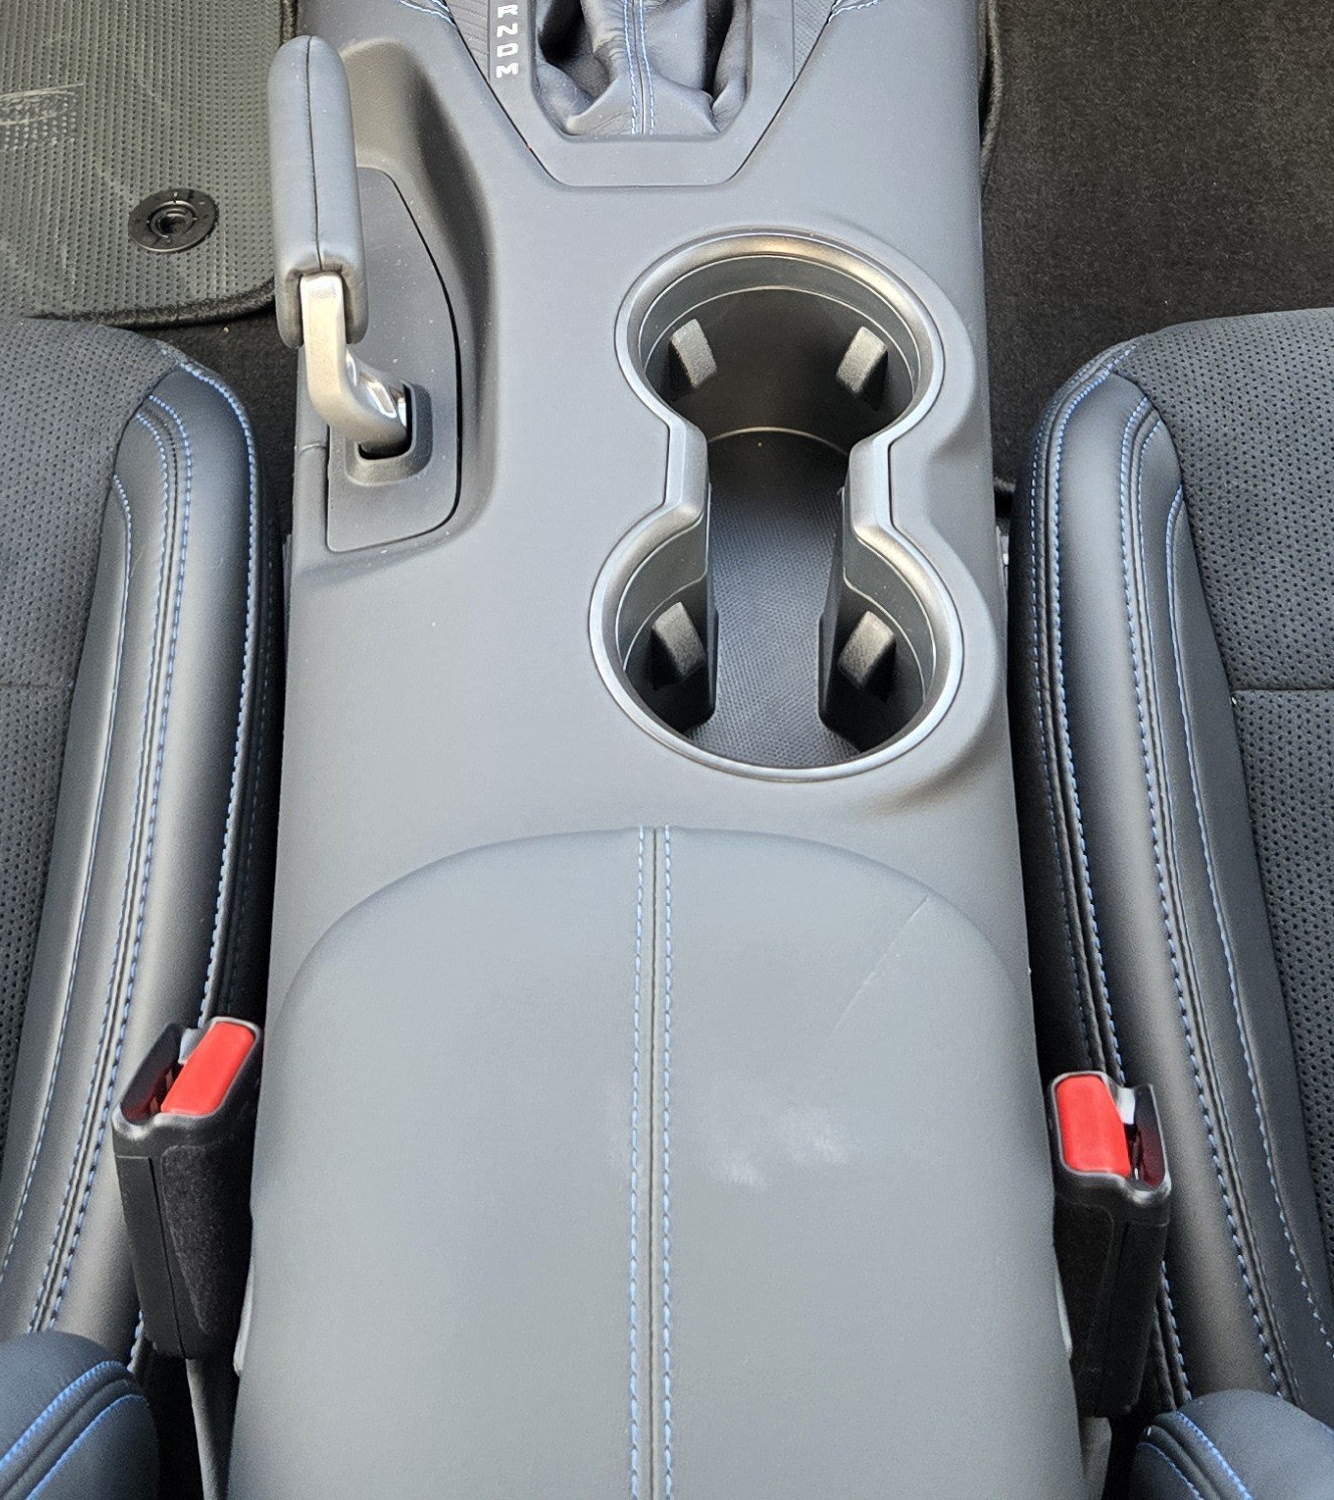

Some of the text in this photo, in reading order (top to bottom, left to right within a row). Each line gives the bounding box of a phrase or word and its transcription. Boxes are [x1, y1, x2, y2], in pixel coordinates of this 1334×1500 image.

[497, 3, 519, 19] R
[496, 23, 519, 38] N
[496, 43, 519, 58] D
[496, 63, 519, 79] M
